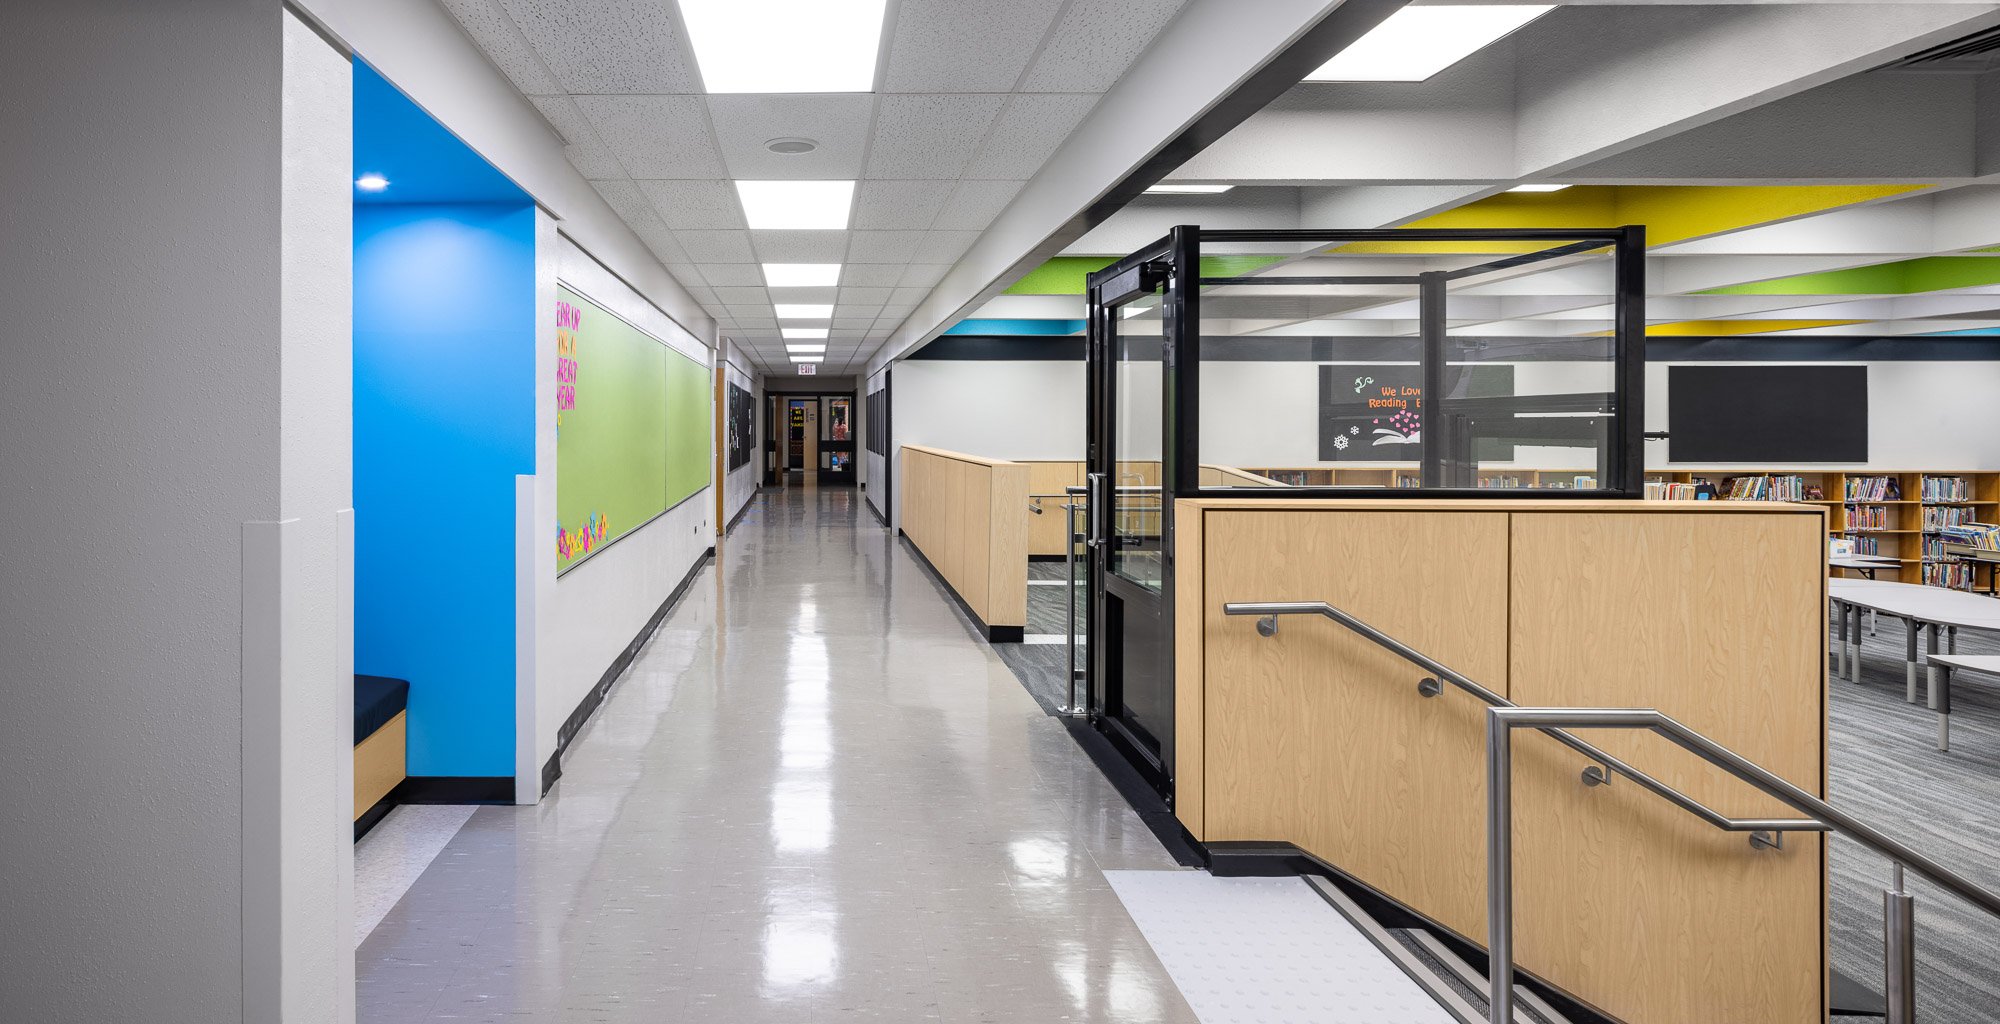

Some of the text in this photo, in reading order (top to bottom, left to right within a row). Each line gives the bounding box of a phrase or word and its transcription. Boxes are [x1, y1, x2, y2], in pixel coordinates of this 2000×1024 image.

[557, 301, 581, 332] EAR UP
[557, 329, 577, 360] OR A
[557, 357, 578, 384] REAT
[557, 385, 576, 411] YEAR
[1368, 397, 1407, 410] Reading
[1381, 386, 1397, 397] We
